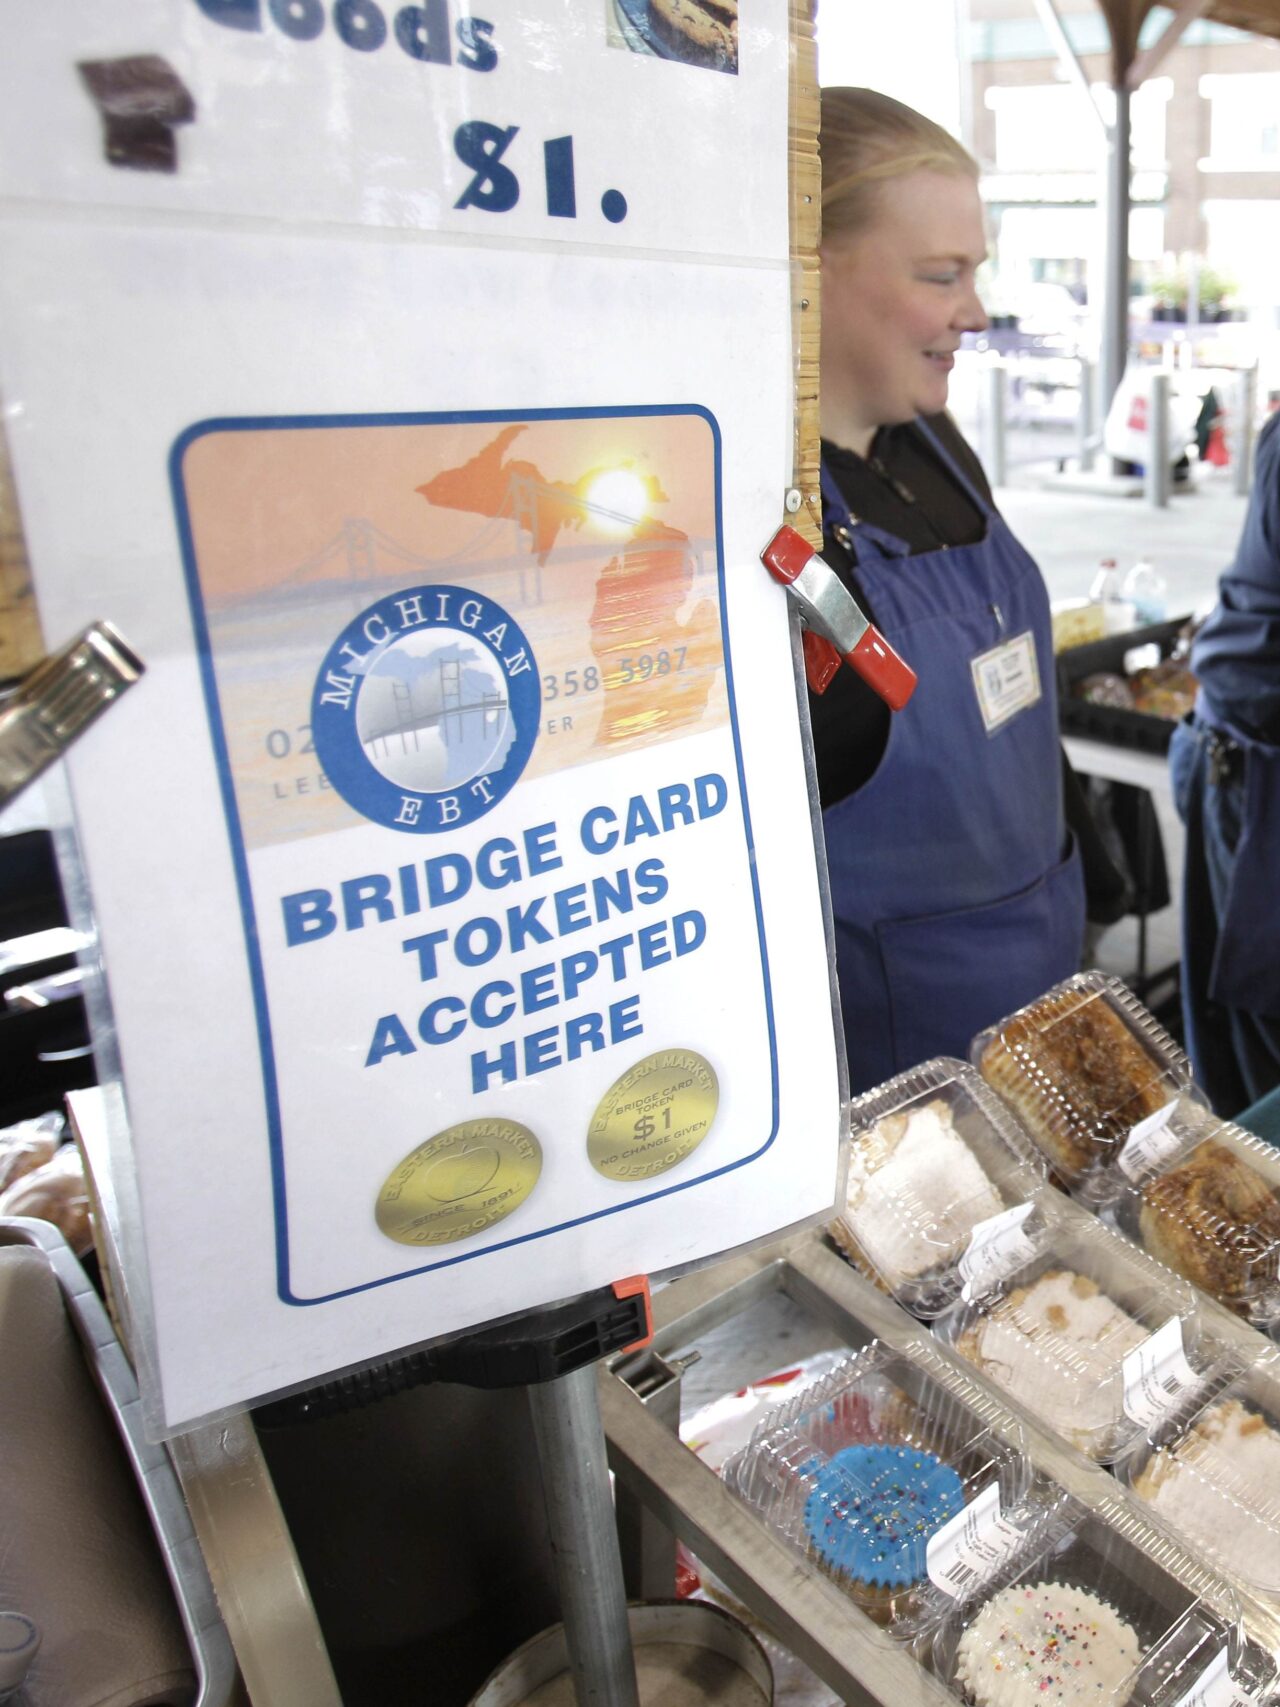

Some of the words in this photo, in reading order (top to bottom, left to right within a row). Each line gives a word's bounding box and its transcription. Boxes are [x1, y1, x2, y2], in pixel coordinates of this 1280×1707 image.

[453, 120, 628, 224] $1.
[320, 594, 532, 711] MICHIGAN
[620, 647, 688, 683] 5987
[394, 776, 496, 826] EBT
[280, 821, 563, 948] BRIDGE
[580, 773, 728, 855] CARD
[402, 858, 669, 982] TOKENS
[364, 910, 707, 1067] ACCEPTED
[472, 994, 644, 1094] HERE
[662, 1055, 715, 1091] MARKET
[616, 1092, 660, 1115] BRIDGE
[662, 1079, 693, 1098] CARD
[636, 1094, 675, 1114] TOKEN
[471, 1124, 535, 1160] MARKET
[600, 1155, 618, 1166] NO
[622, 1135, 672, 1159] CHANGE
[673, 1120, 707, 1139] GIVEN
[633, 1108, 672, 1141] $1
[411, 1205, 507, 1242] DETROIT
